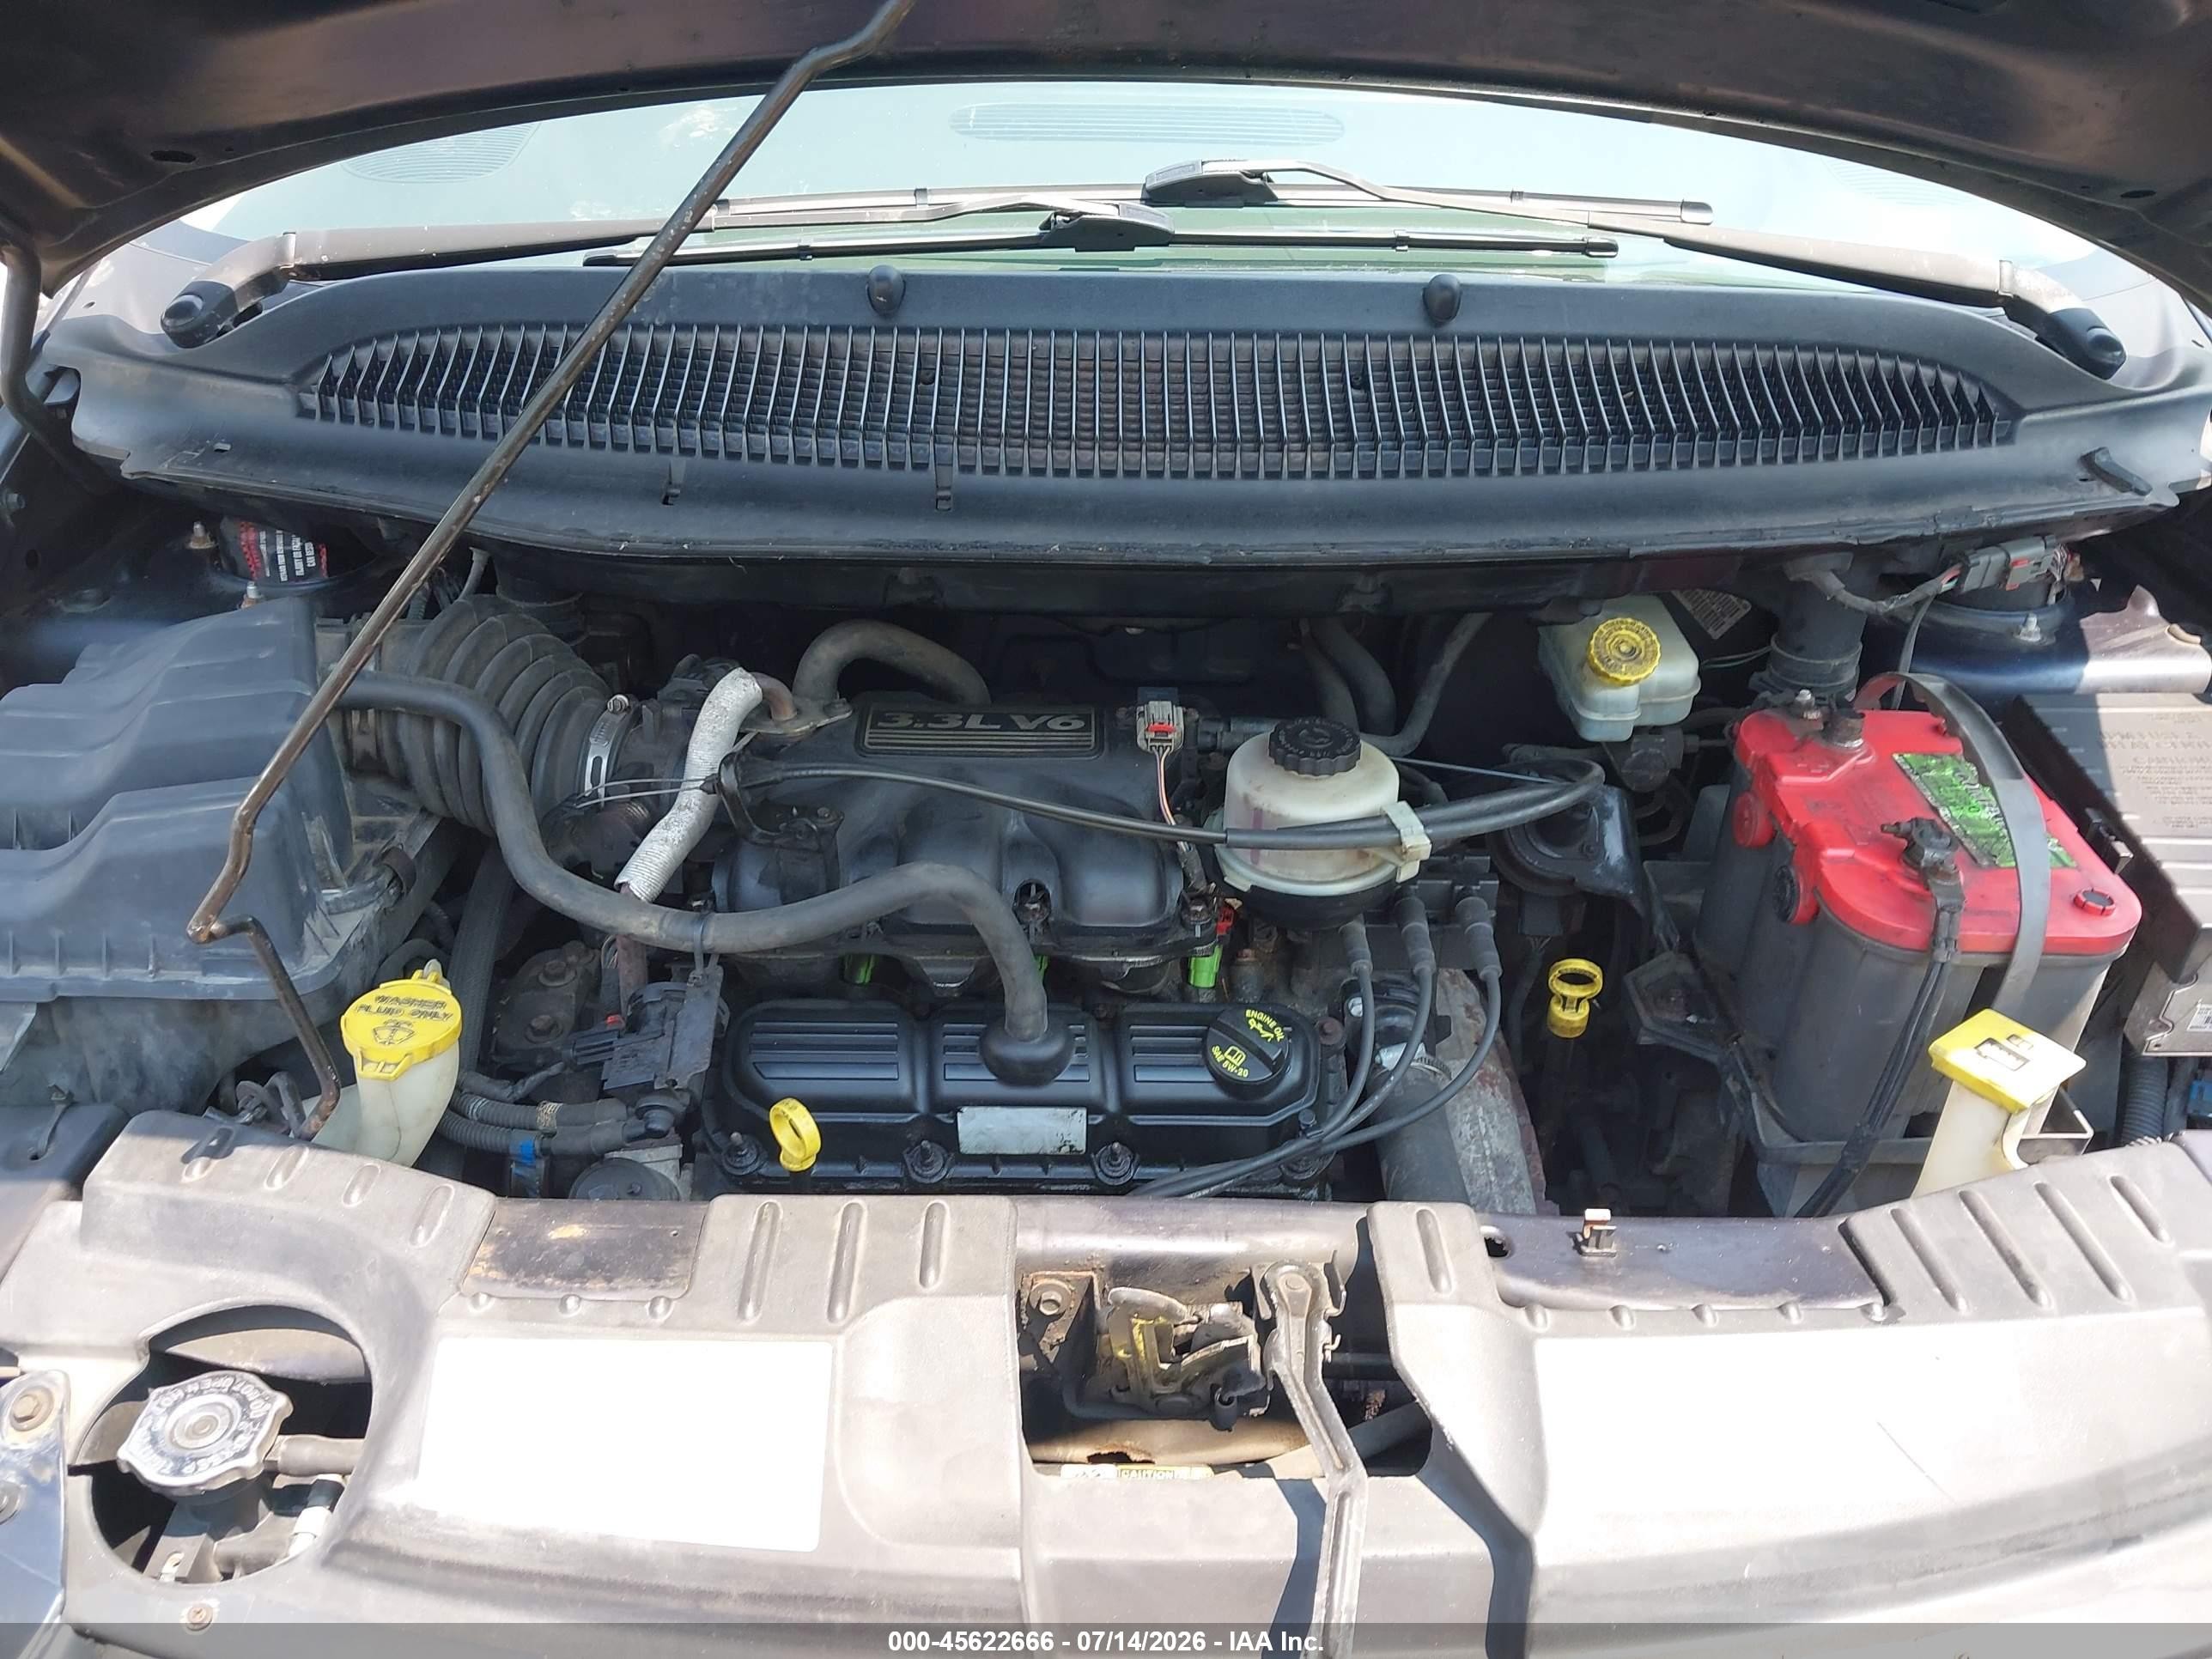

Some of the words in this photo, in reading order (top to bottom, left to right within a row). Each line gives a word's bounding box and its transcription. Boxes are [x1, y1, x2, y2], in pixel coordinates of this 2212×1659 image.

[878, 713, 1001, 730] 3.3L
[1010, 714, 1085, 731] V6
[374, 995, 447, 1010] WASHER
[356, 1004, 405, 1016] FLUID
[410, 1008, 454, 1022] ONLY
[1245, 1009, 1278, 1030] ENGINE
[1273, 1026, 1285, 1042] OIL
[1212, 1045, 1225, 1063] SAE
[185, 1375, 236, 1395] OPEN
[1121, 1468, 1174, 1480] CAUTION
